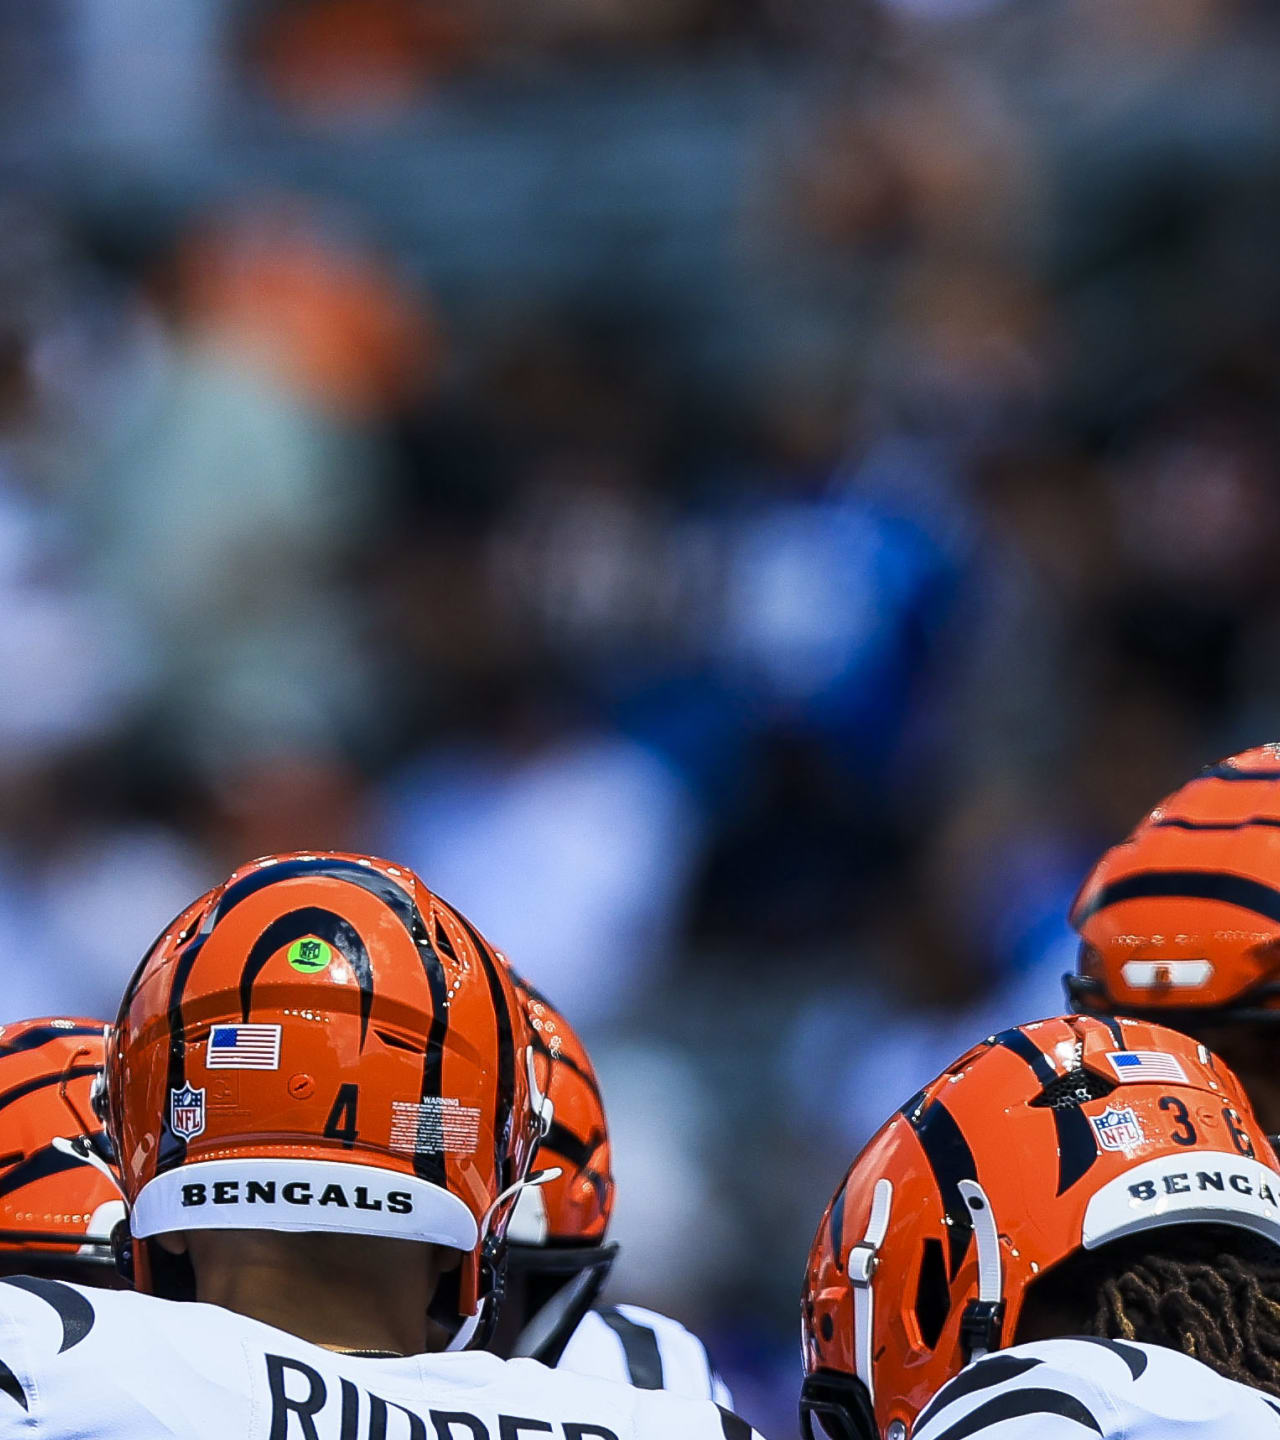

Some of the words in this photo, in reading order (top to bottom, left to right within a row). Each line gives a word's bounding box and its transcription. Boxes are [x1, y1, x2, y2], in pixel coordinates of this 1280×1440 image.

[175, 1109, 200, 1131] NFL
[323, 1083, 360, 1150] 4
[1102, 1125, 1136, 1145] NFL
[181, 1181, 413, 1215] BENGALS
